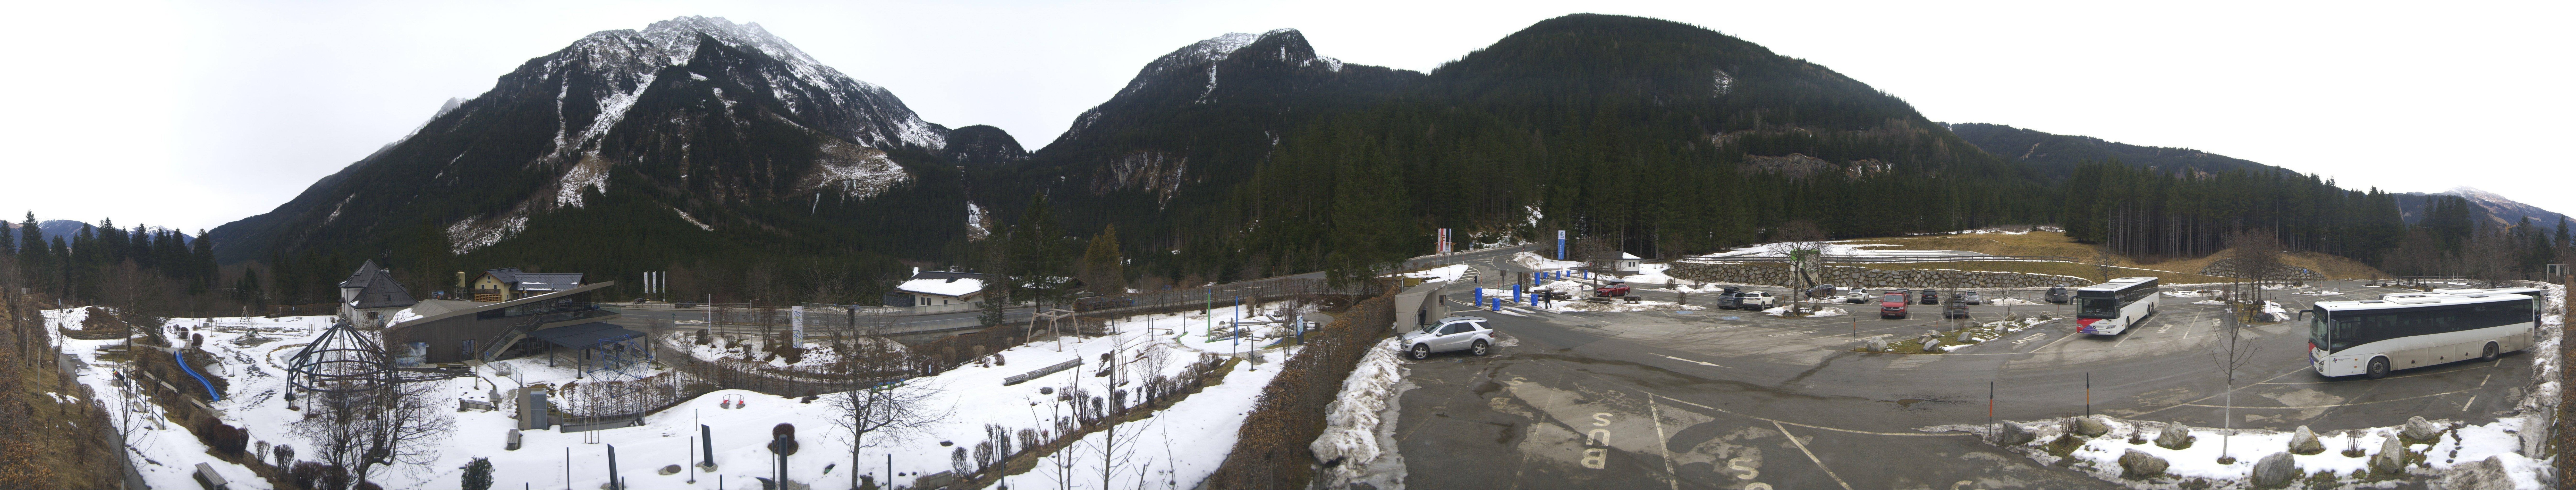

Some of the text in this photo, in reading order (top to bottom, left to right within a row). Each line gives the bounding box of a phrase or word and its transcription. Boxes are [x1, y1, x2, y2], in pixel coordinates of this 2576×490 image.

[2156, 324, 2173, 333] BUS
[2012, 333, 2046, 344] BUS
[1581, 412, 1613, 469] BUS
